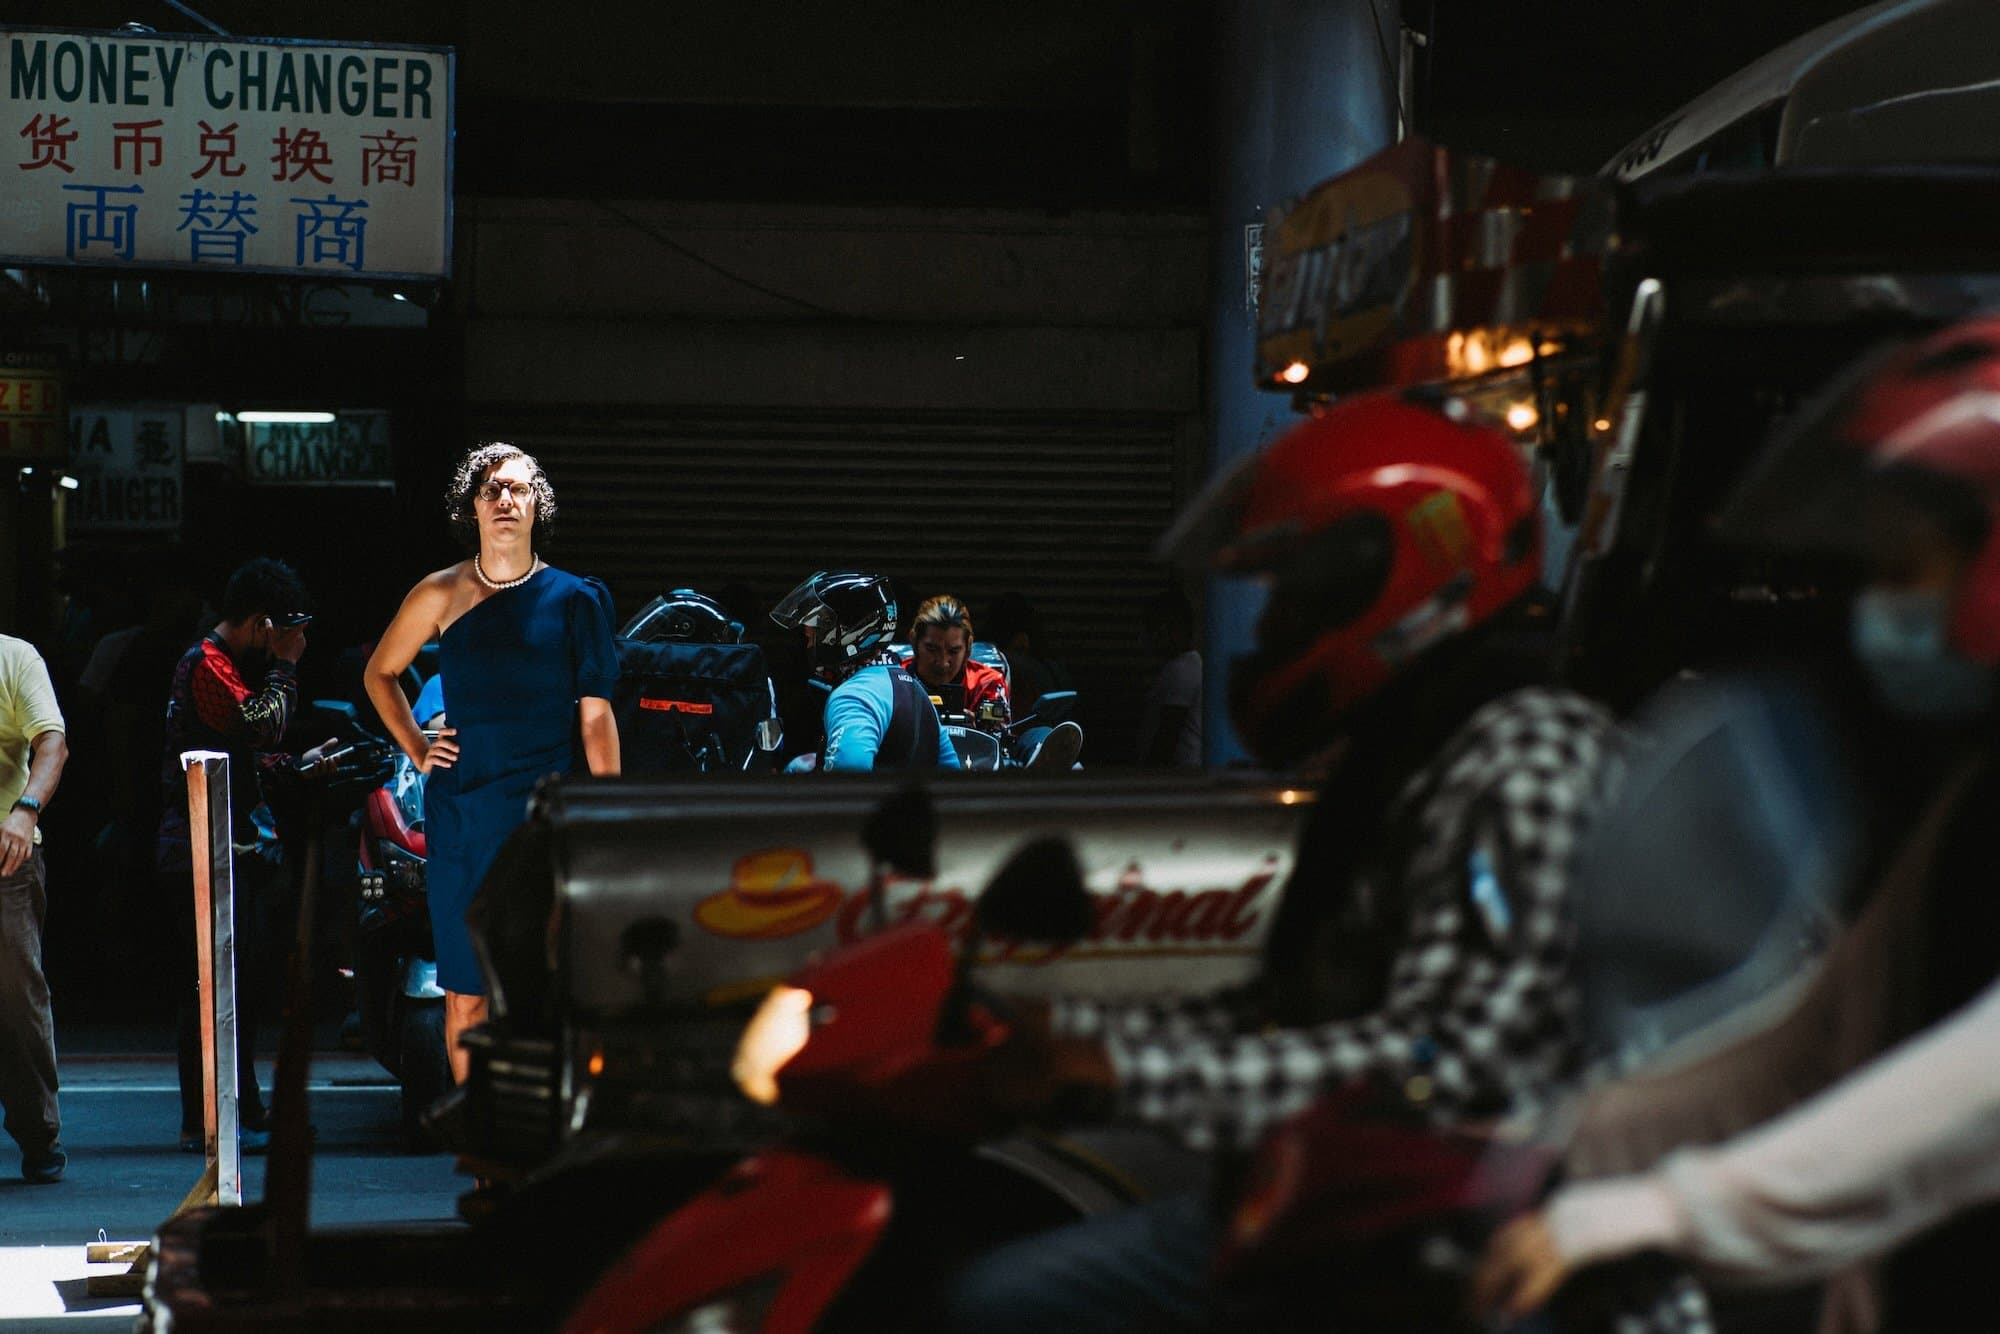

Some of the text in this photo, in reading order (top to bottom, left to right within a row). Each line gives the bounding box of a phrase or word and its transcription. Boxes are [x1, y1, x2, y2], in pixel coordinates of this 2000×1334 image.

[10, 39, 433, 119] MONEY CHANGER
[18, 113, 418, 187] 货币兑换商
[62, 183, 369, 272] 両替商
